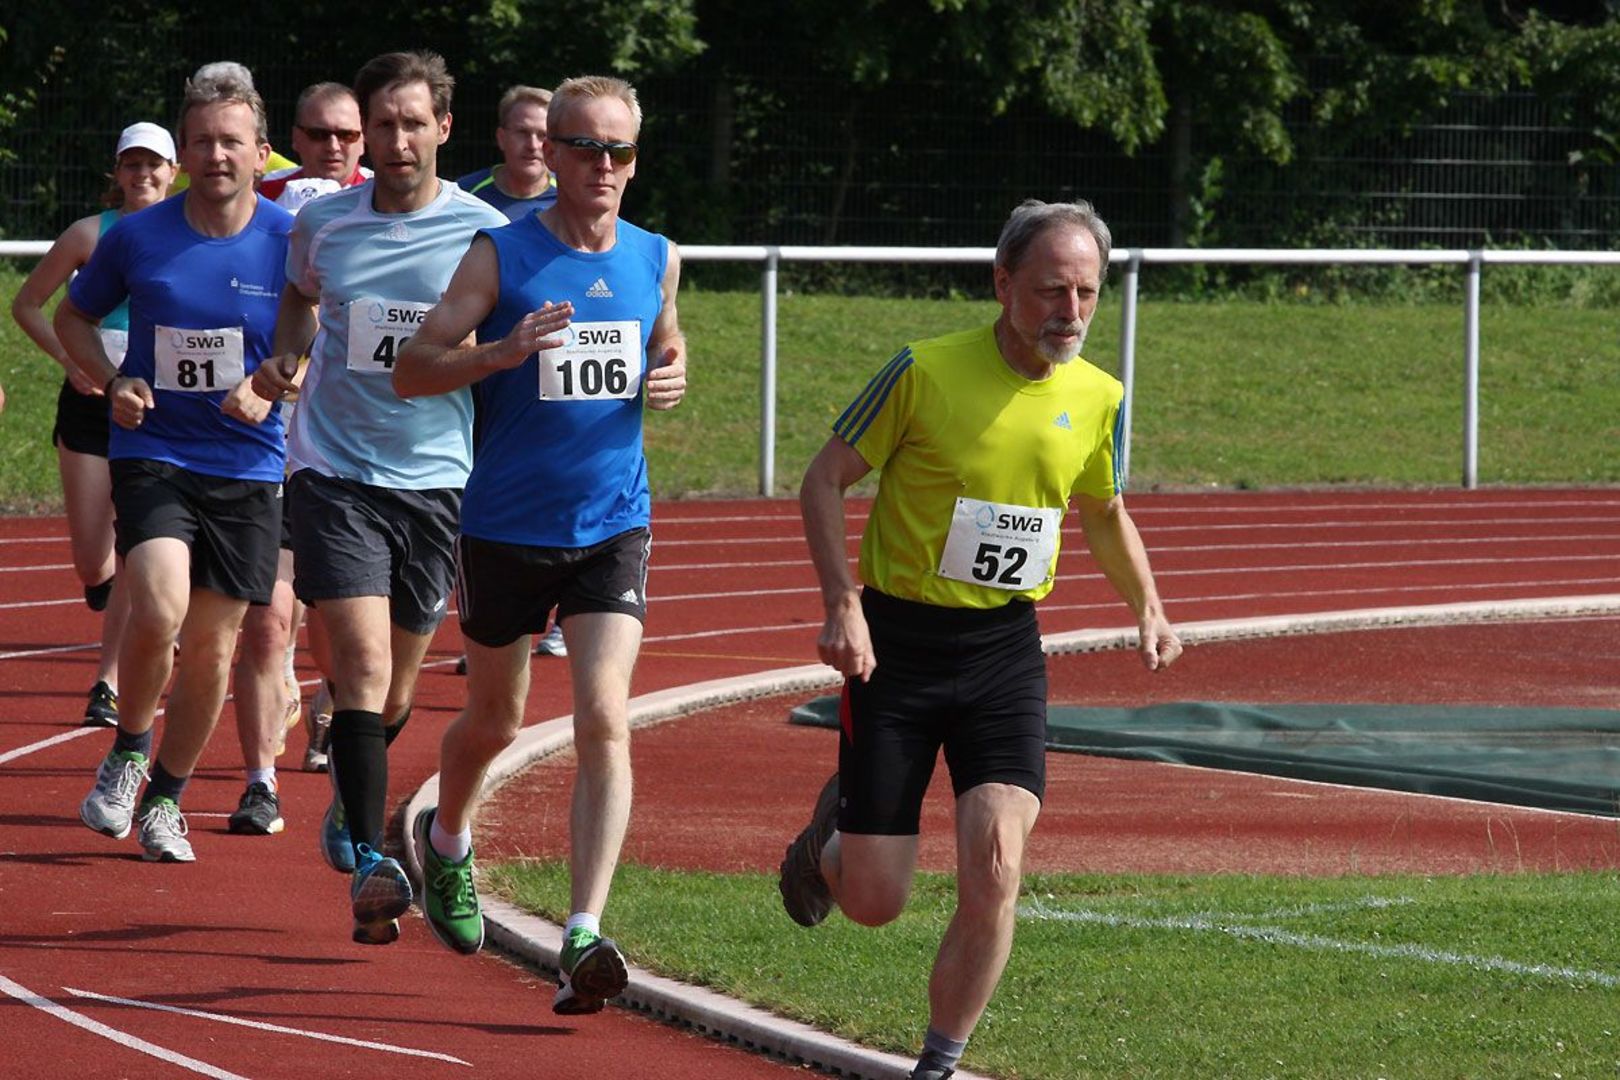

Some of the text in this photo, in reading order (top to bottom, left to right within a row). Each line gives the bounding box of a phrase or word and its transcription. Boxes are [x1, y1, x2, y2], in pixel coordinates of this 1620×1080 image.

[186, 335, 225, 349] swa
[578, 329, 622, 345] swa
[372, 335, 412, 369] 4
[177, 359, 215, 388] 81
[556, 358, 627, 396] 106
[996, 513, 1043, 533] swa
[971, 542, 1028, 586] 52
